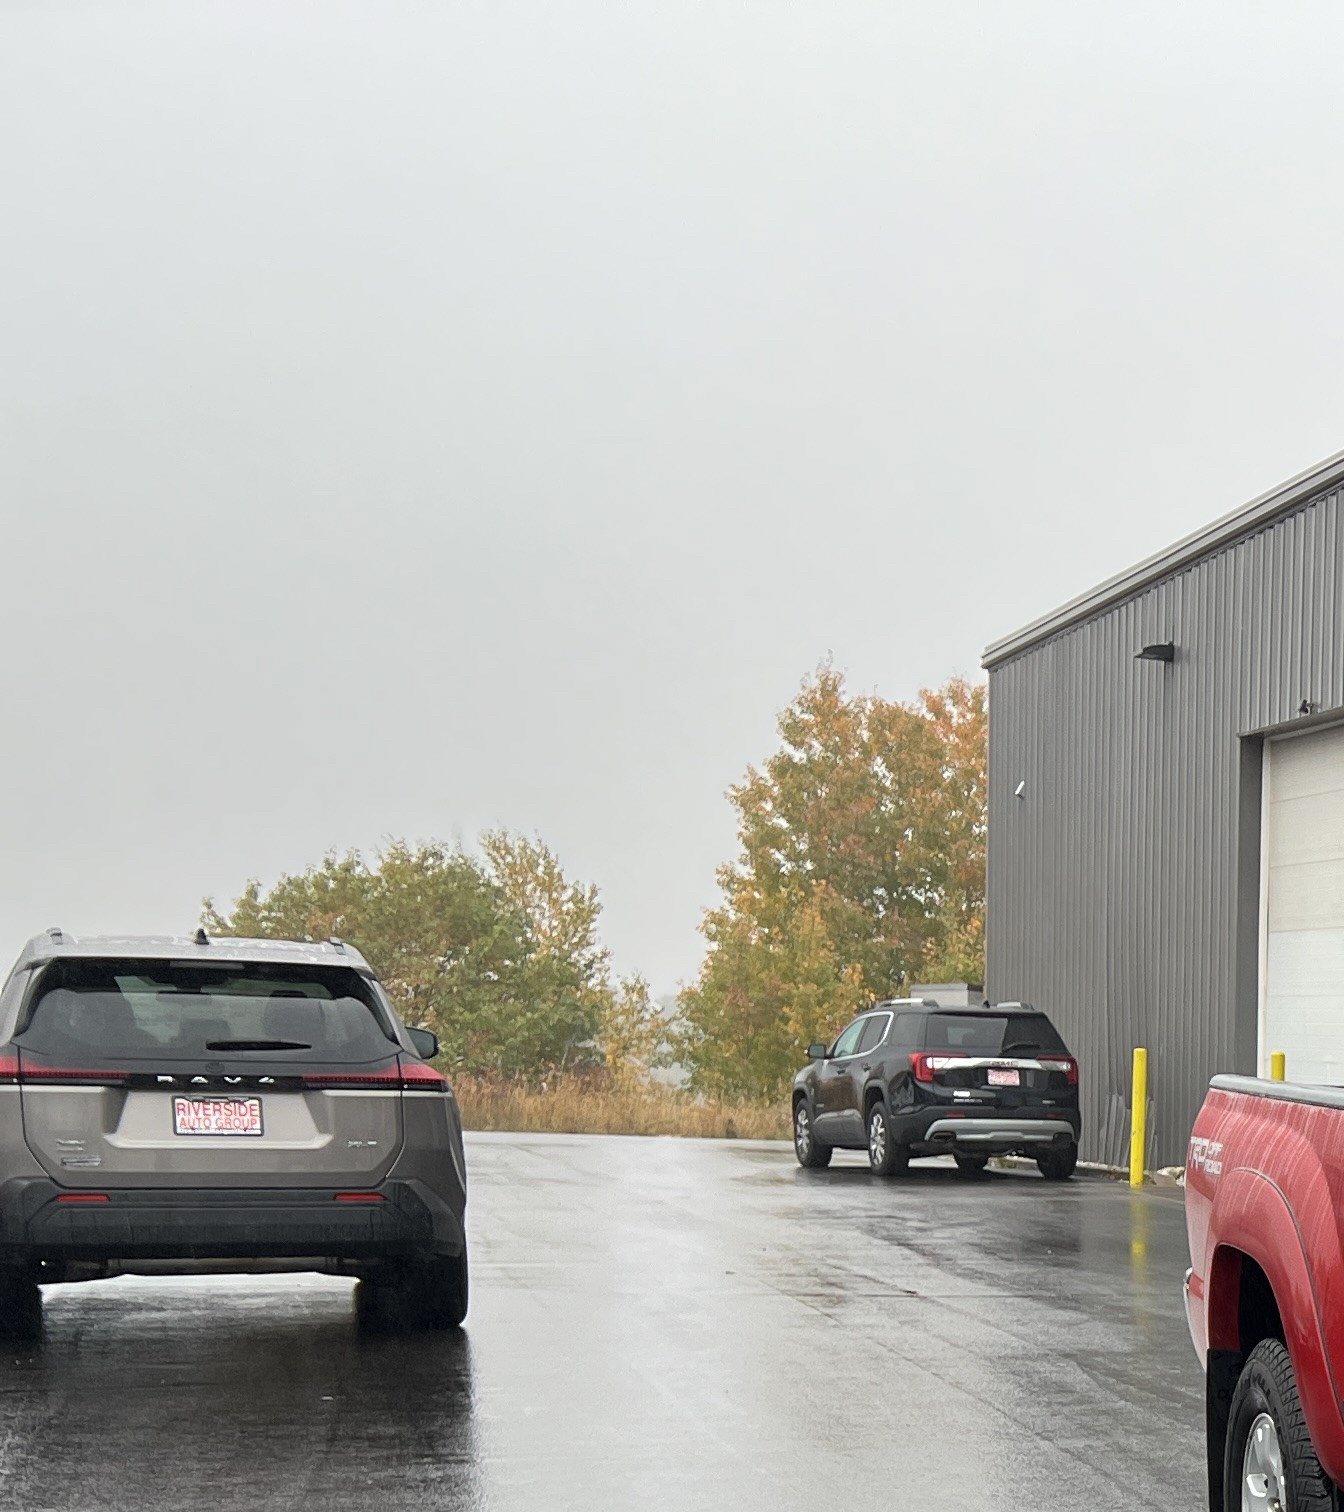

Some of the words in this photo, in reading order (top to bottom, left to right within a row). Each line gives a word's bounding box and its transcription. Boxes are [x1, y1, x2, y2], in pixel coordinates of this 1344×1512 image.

[176, 1102, 259, 1118] RIVERSIDE
[179, 1117, 211, 1130] AUTO
[215, 1117, 258, 1130] GROUP
